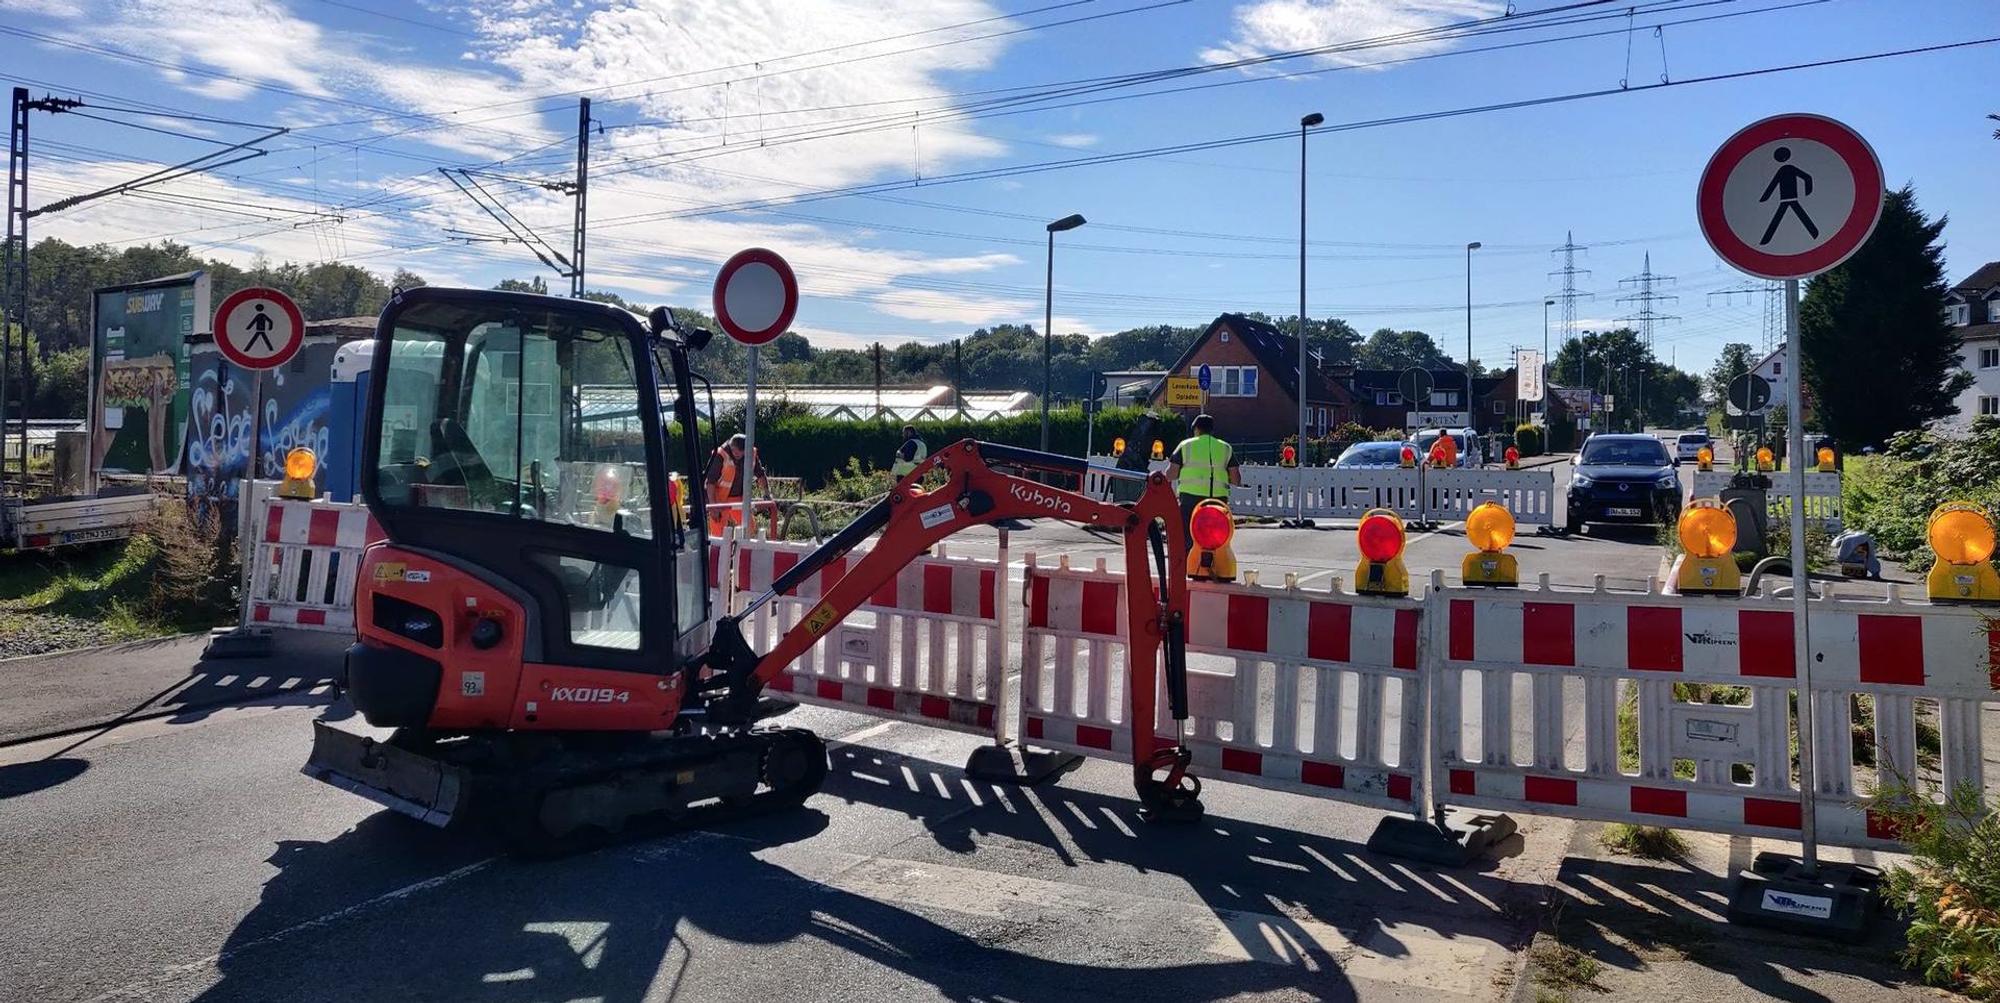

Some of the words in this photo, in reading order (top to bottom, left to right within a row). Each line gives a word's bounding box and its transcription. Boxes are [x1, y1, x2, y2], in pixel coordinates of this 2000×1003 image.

[126, 292, 164, 314] SUBWAY
[1010, 483, 1072, 515] Kubota
[464, 682, 476, 694] 93
